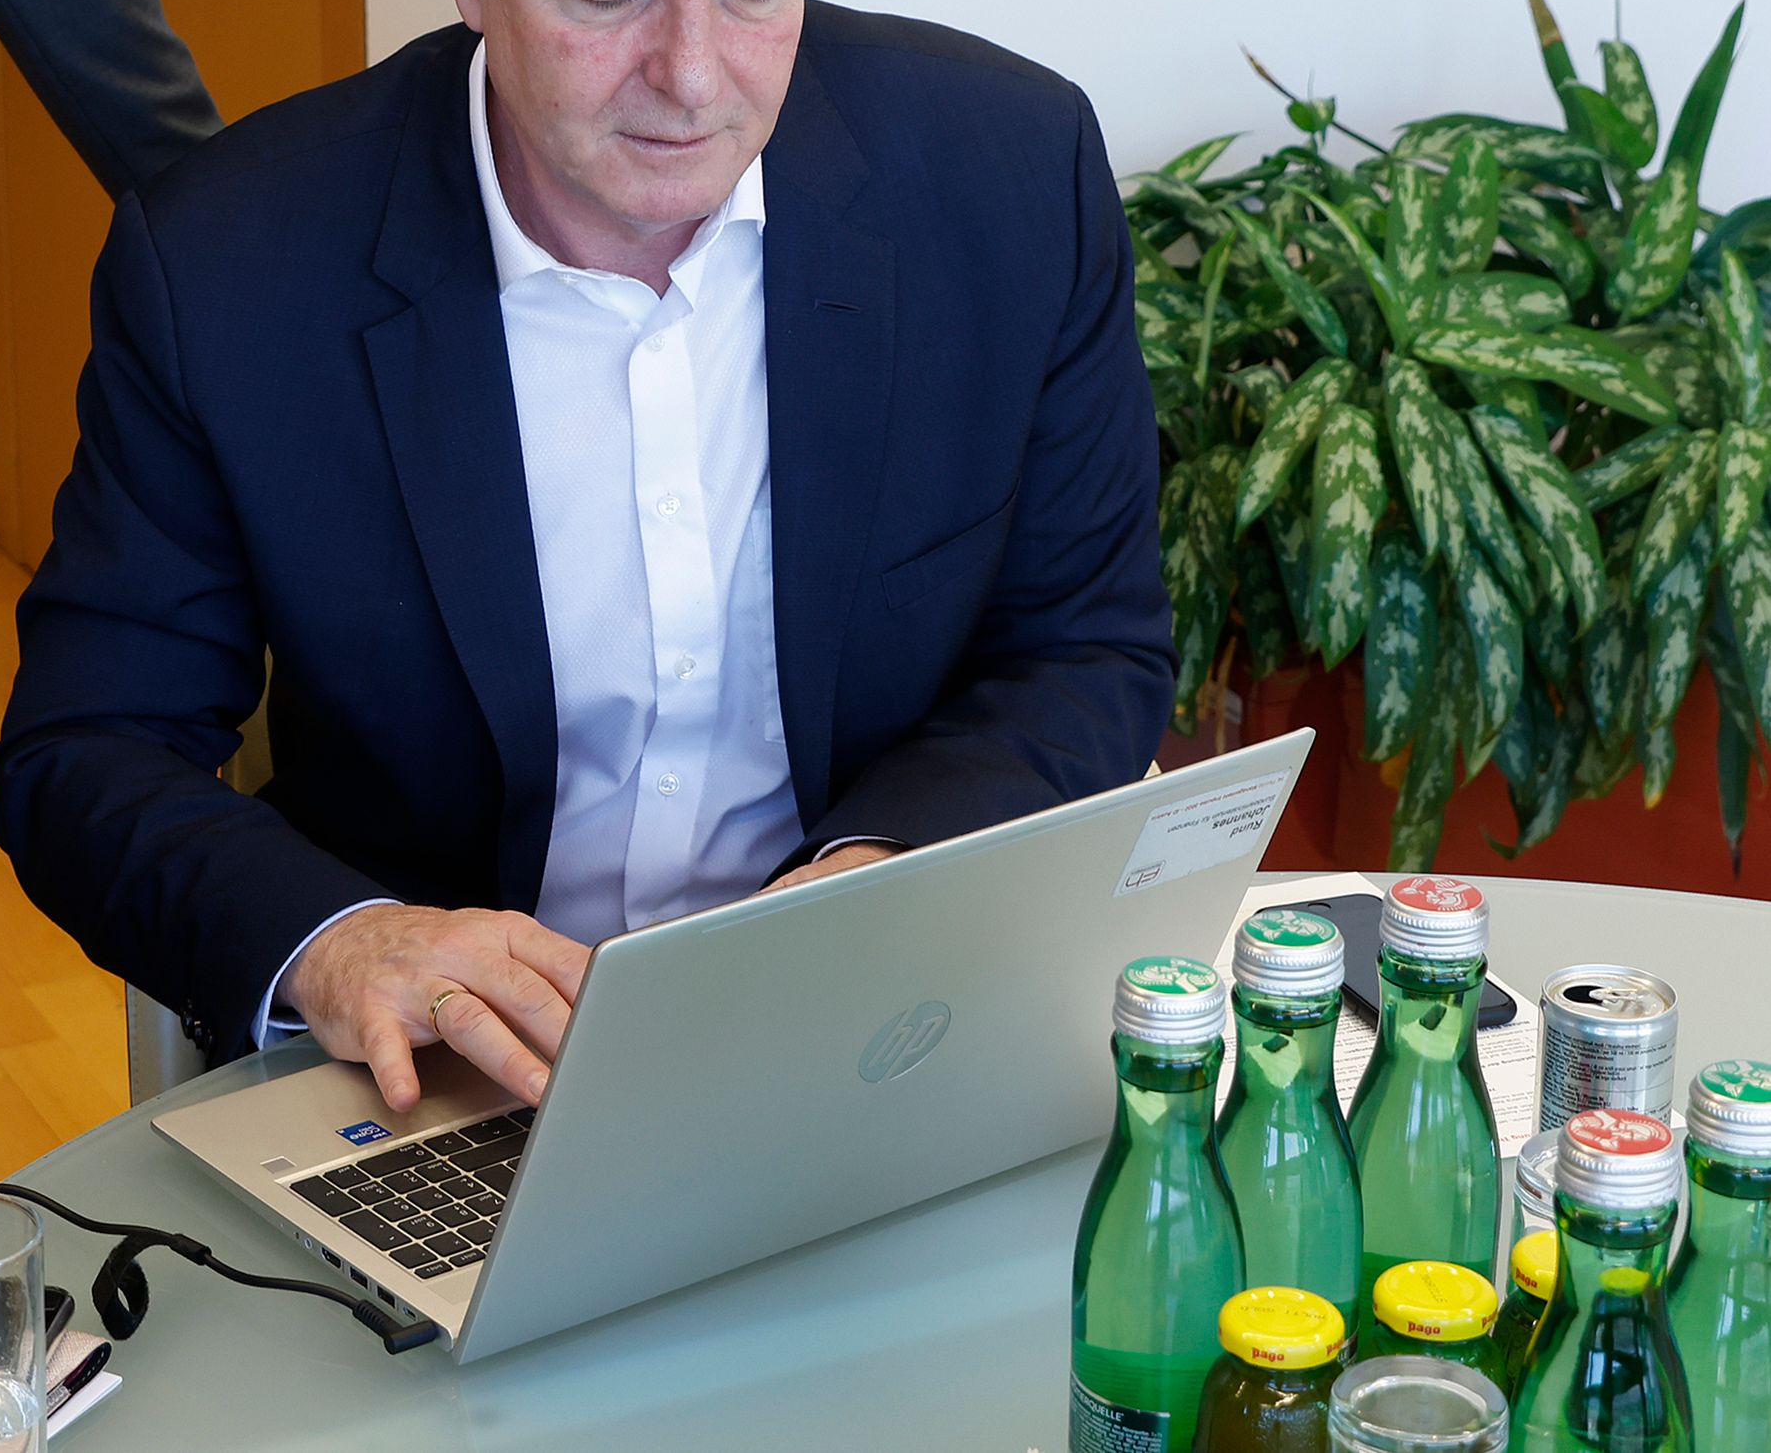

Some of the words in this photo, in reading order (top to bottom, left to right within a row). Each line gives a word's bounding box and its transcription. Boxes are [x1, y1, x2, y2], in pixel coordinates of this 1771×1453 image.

[1211, 805, 1271, 830] Johannes
[1229, 818, 1264, 838] Rund
[864, 1002, 948, 1083] hp
[1516, 1268, 1538, 1289] pago
[1407, 1321, 1441, 1336] pago
[1251, 1347, 1285, 1363] pago
